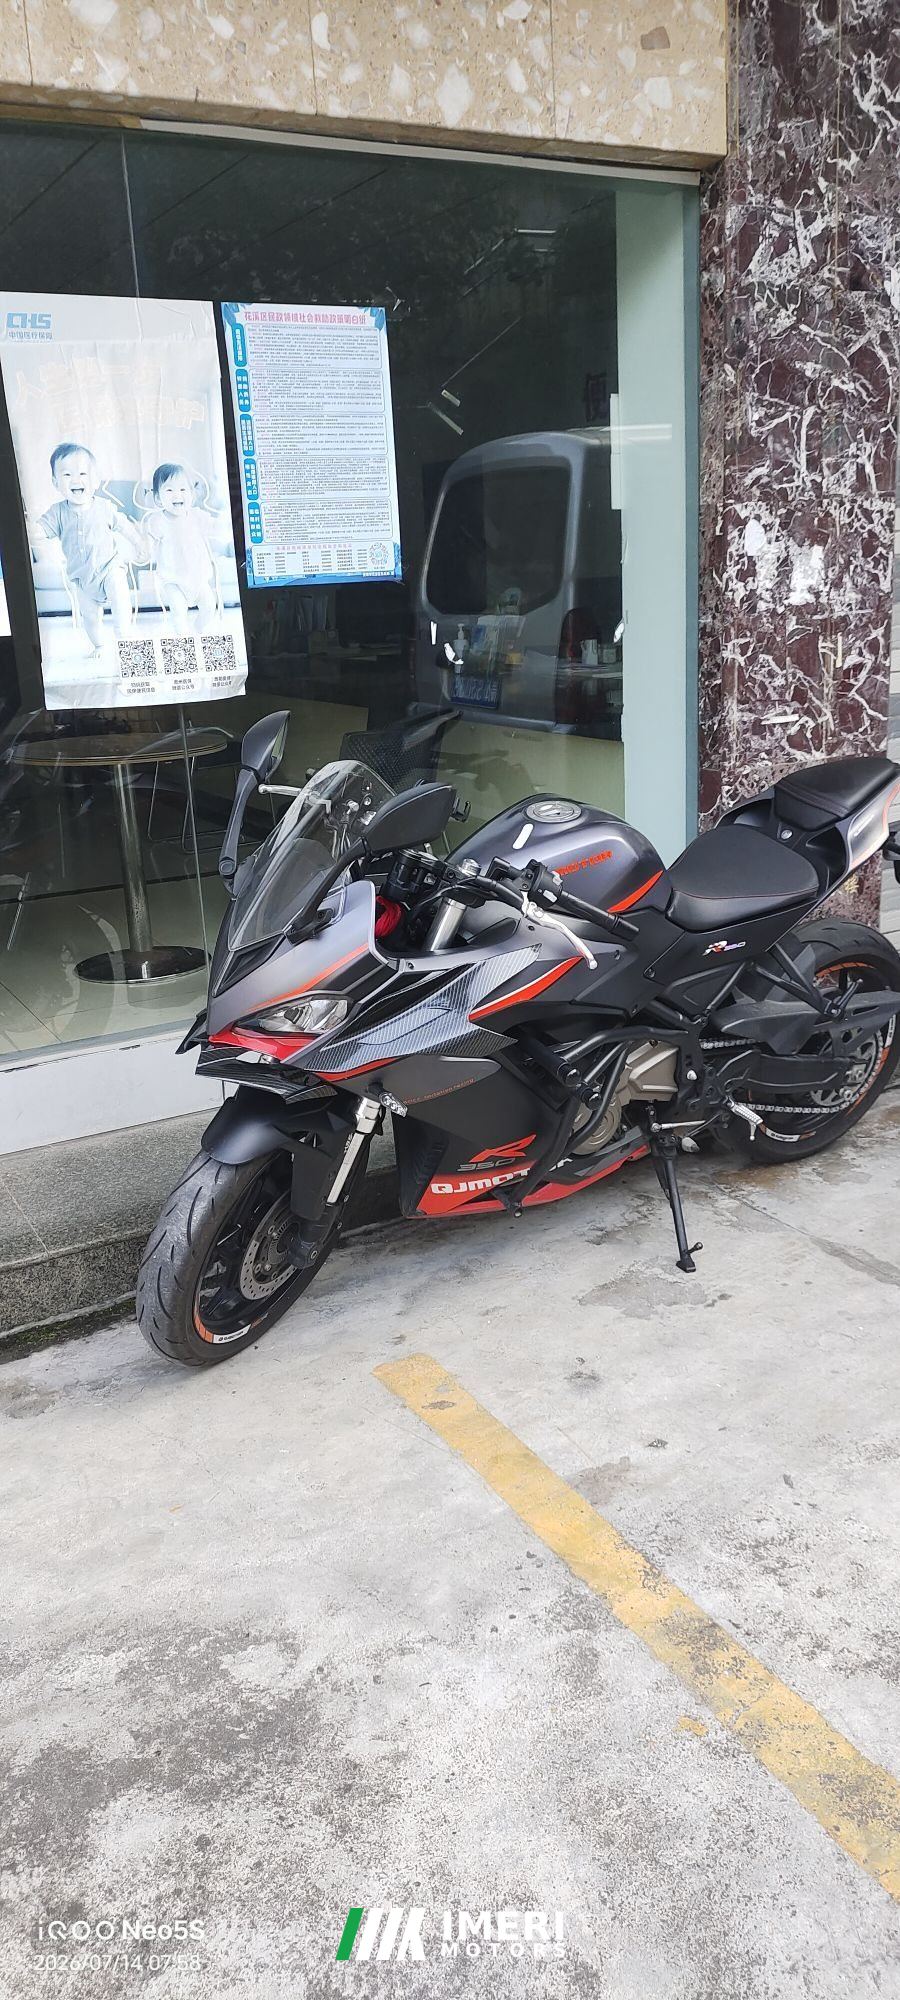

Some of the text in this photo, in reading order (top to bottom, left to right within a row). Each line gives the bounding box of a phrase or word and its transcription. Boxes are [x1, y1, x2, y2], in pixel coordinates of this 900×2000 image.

[7, 312, 52, 329] CHS
[244, 311, 366, 325] 花溪区民政领域社会救助政策明白纸
[8, 331, 53, 340] 中国医疗保障
[457, 1157, 515, 1172] 350
